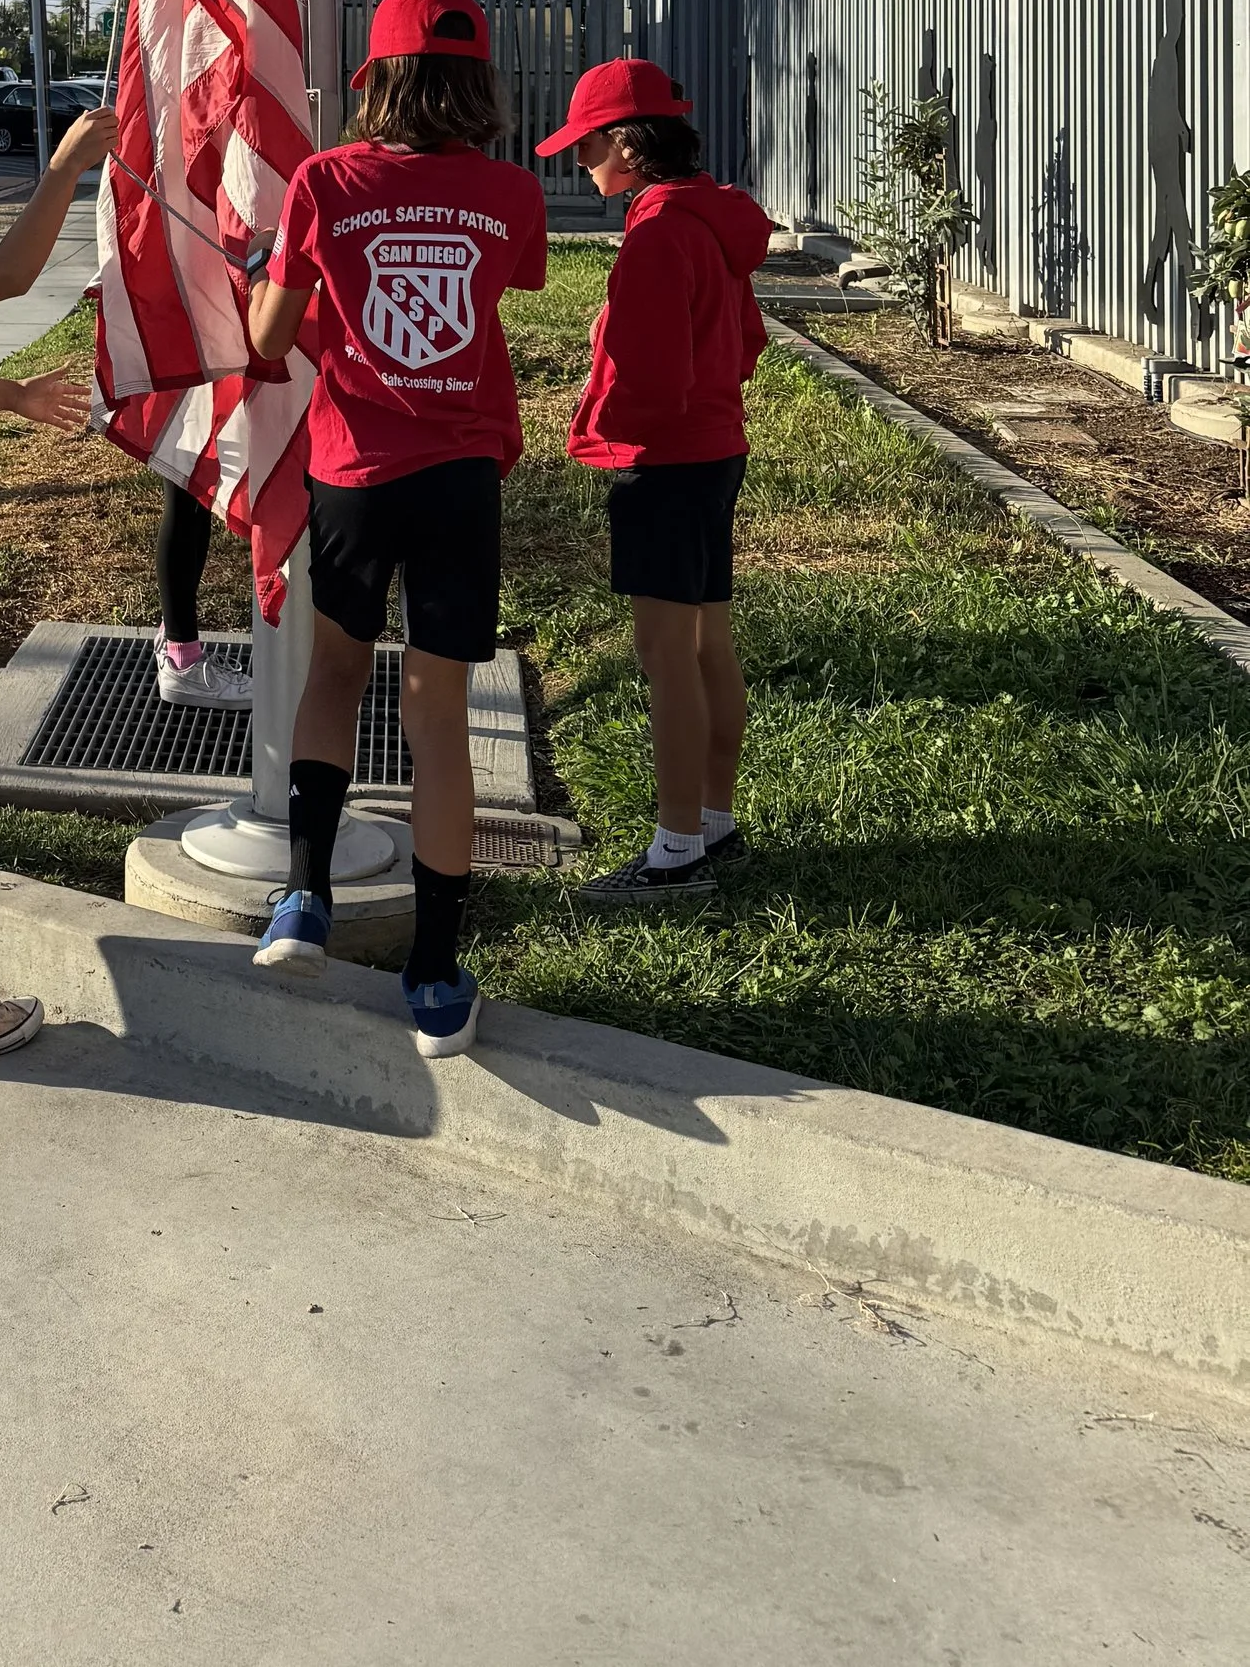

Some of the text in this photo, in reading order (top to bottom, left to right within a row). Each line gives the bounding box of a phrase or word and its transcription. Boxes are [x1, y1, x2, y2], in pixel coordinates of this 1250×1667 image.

[332, 205, 510, 241] SCHOOL SAFETY PATROL
[378, 245, 467, 266] SAN DIEGO
[381, 372, 474, 394] Safe Crossing Since
